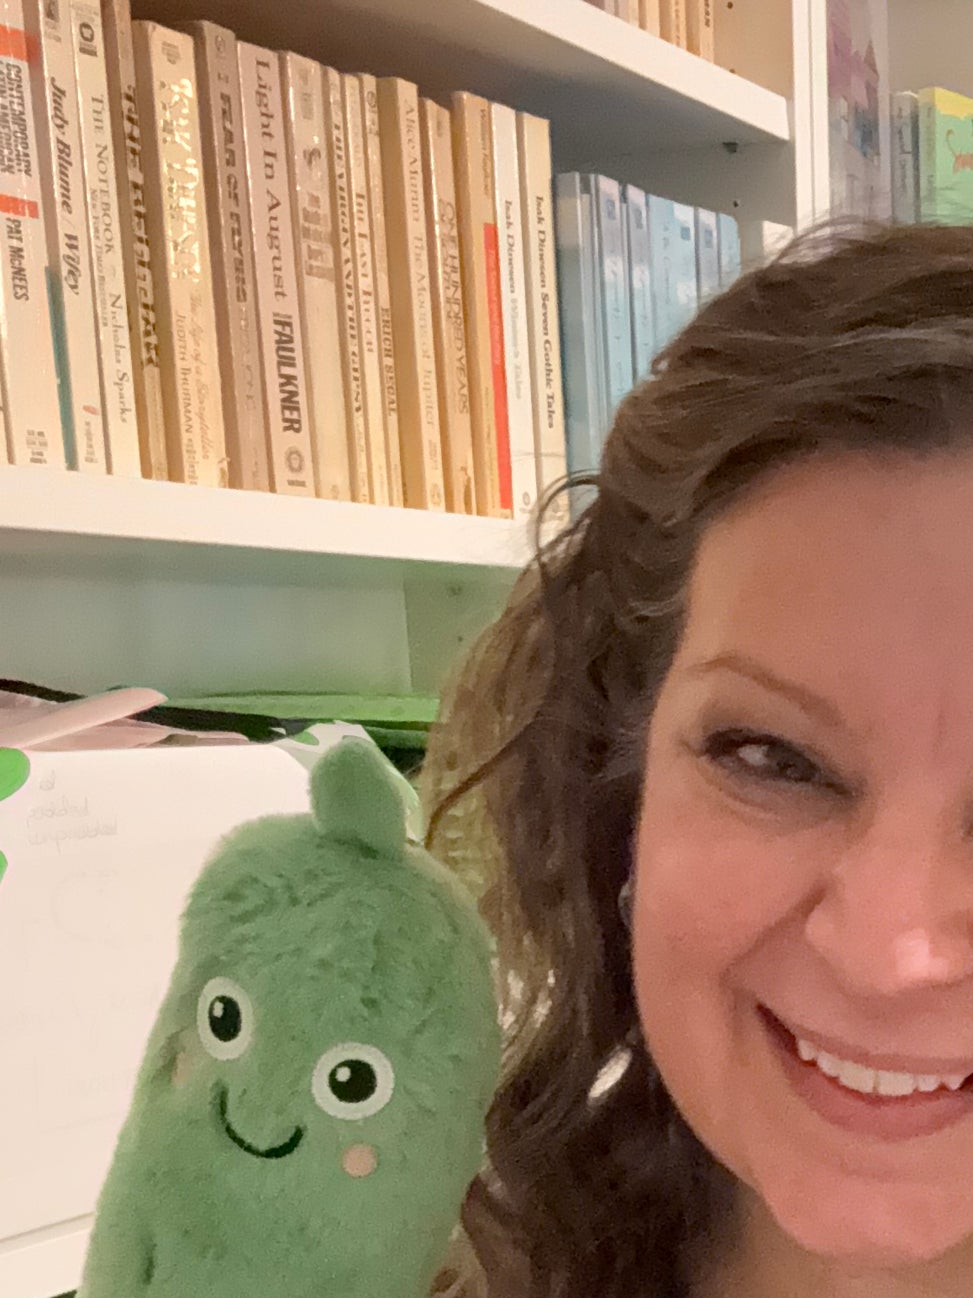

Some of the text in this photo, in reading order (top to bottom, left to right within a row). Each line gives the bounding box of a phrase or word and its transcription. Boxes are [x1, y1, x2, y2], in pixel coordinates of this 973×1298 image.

[50, 77, 69, 136] Judy
[220, 92, 236, 167] FEAR
[404, 99, 416, 149] Alice
[56, 137, 74, 215] Blume
[94, 144, 115, 254] NOTEBOOK
[227, 173, 240, 208] OF
[255, 57, 288, 301] Light In August
[408, 154, 420, 223] Munro
[504, 200, 513, 229] Isak
[6, 218, 30, 301] PAT McNEES
[64, 233, 82, 295] Wifey
[413, 235, 426, 268] The
[506, 234, 516, 294] Dinesen
[109, 292, 127, 364] Nicholas
[176, 310, 187, 361] JUDITH
[445, 202, 469, 414] ONE HUNDRED YEARS
[536, 195, 557, 429] Isak Dinesen Seven Gothic Tales
[273, 318, 302, 434] FAULKNER
[380, 306, 397, 417] ERICH SEGAL
[112, 369, 132, 424] Sparks
[180, 366, 194, 433] THURMAN
[420, 368, 435, 428] Jupiter
